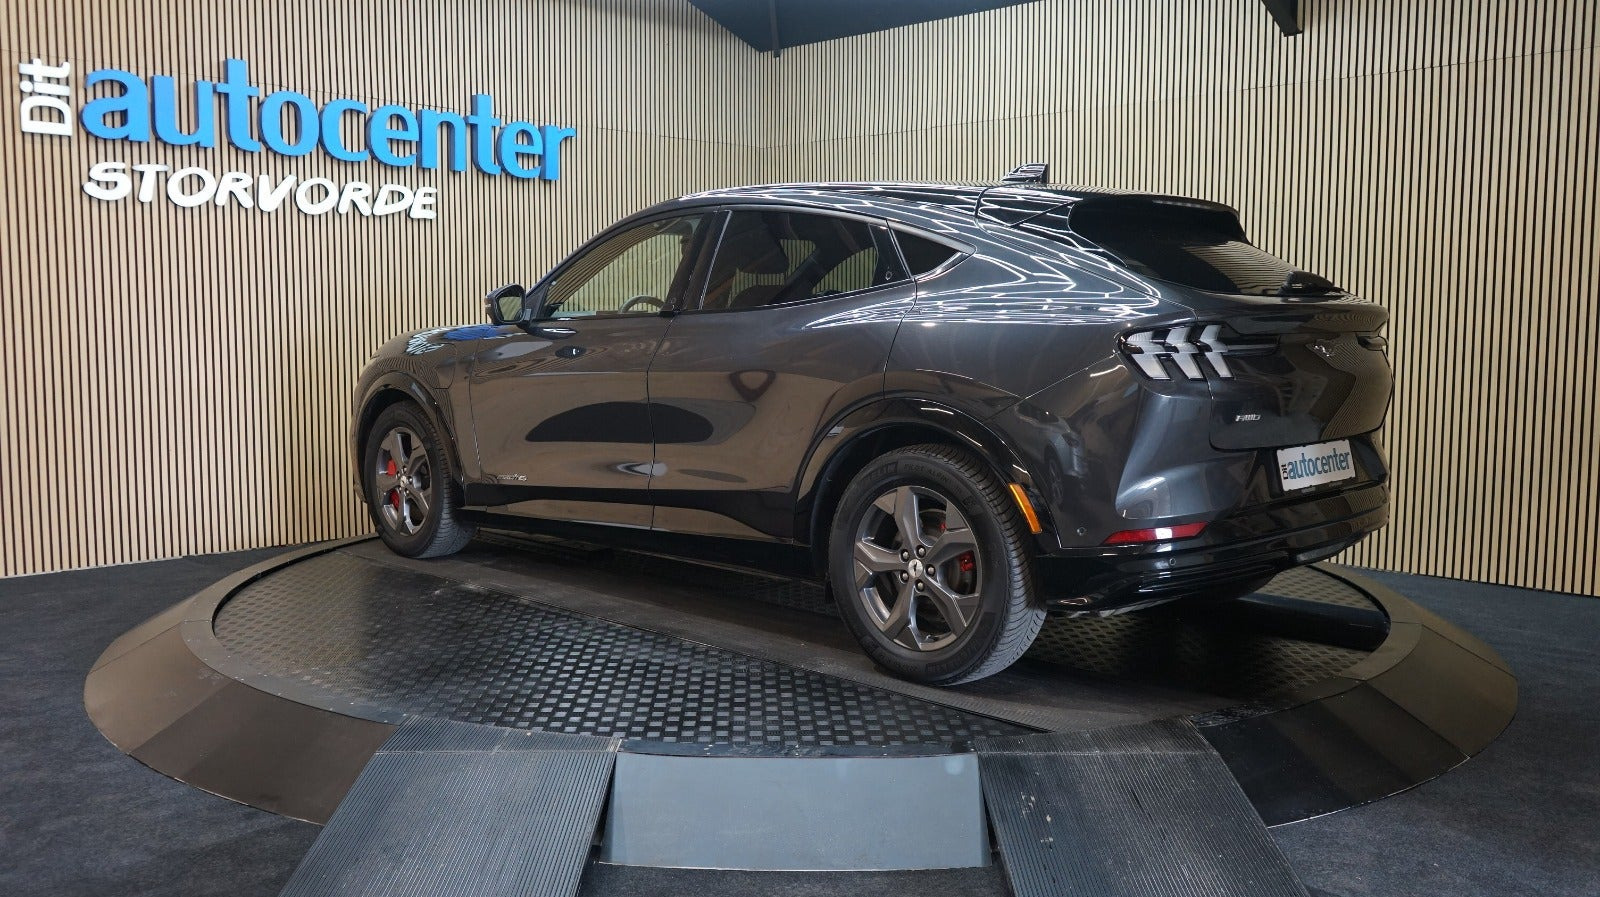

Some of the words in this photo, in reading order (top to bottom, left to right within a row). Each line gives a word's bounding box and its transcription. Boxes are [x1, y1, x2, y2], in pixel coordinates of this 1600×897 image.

[19, 58, 73, 136] Dit
[80, 58, 577, 182] autocenter
[83, 161, 438, 220] STORVORDE
[1287, 448, 1350, 479] autocenter
